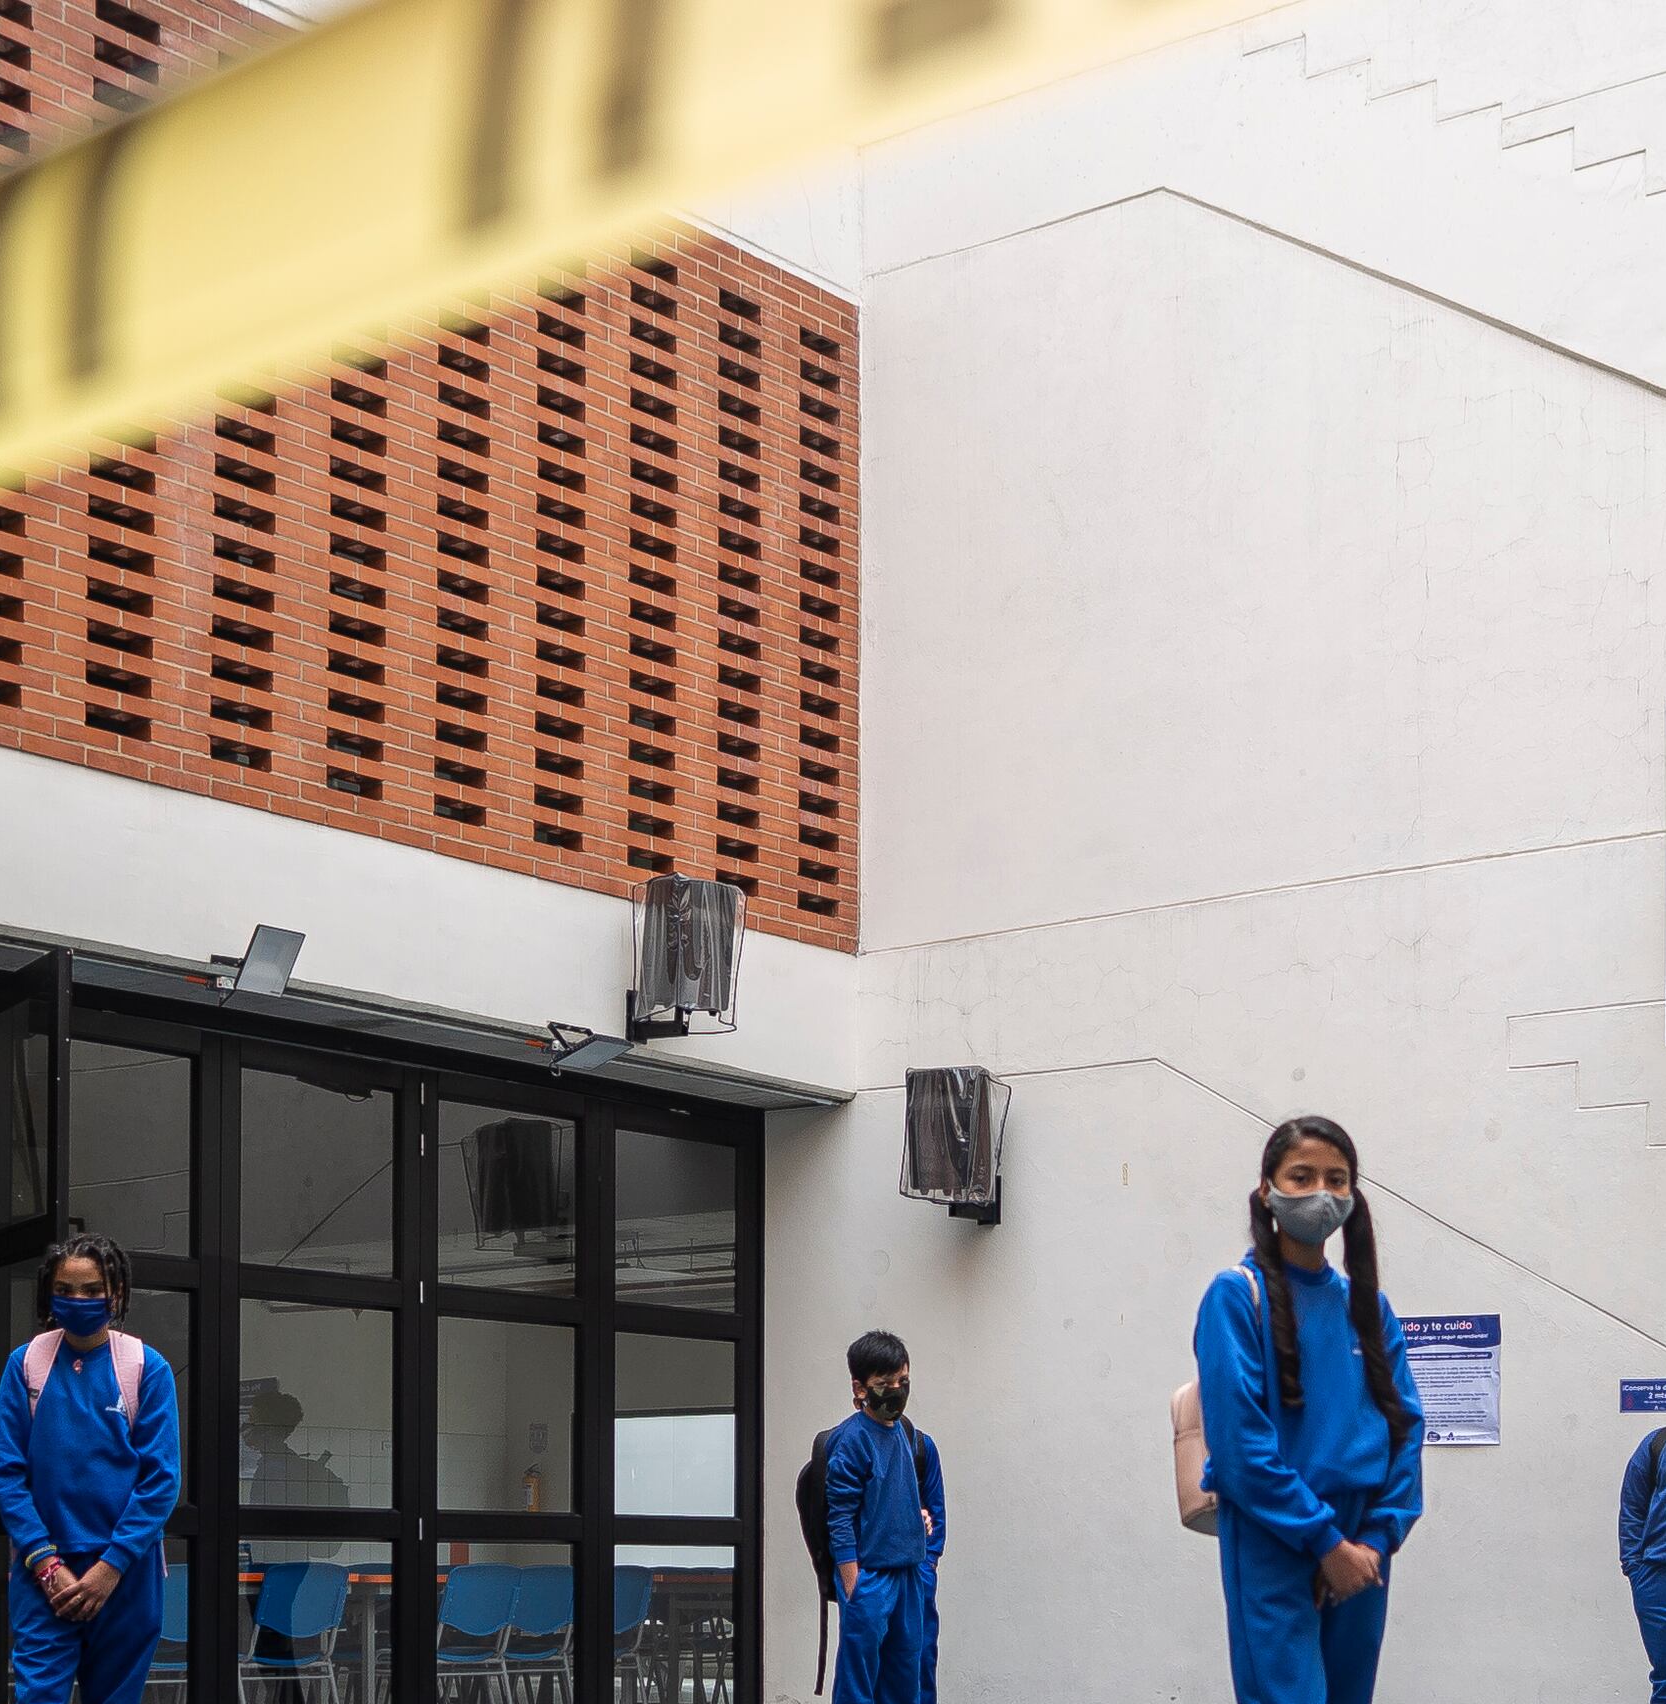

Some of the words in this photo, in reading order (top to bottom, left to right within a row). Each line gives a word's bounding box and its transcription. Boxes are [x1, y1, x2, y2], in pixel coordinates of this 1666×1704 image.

[1422, 1323, 1429, 1332] y
[1431, 1321, 1442, 1331] te
[1444, 1320, 1473, 1331] cuido
